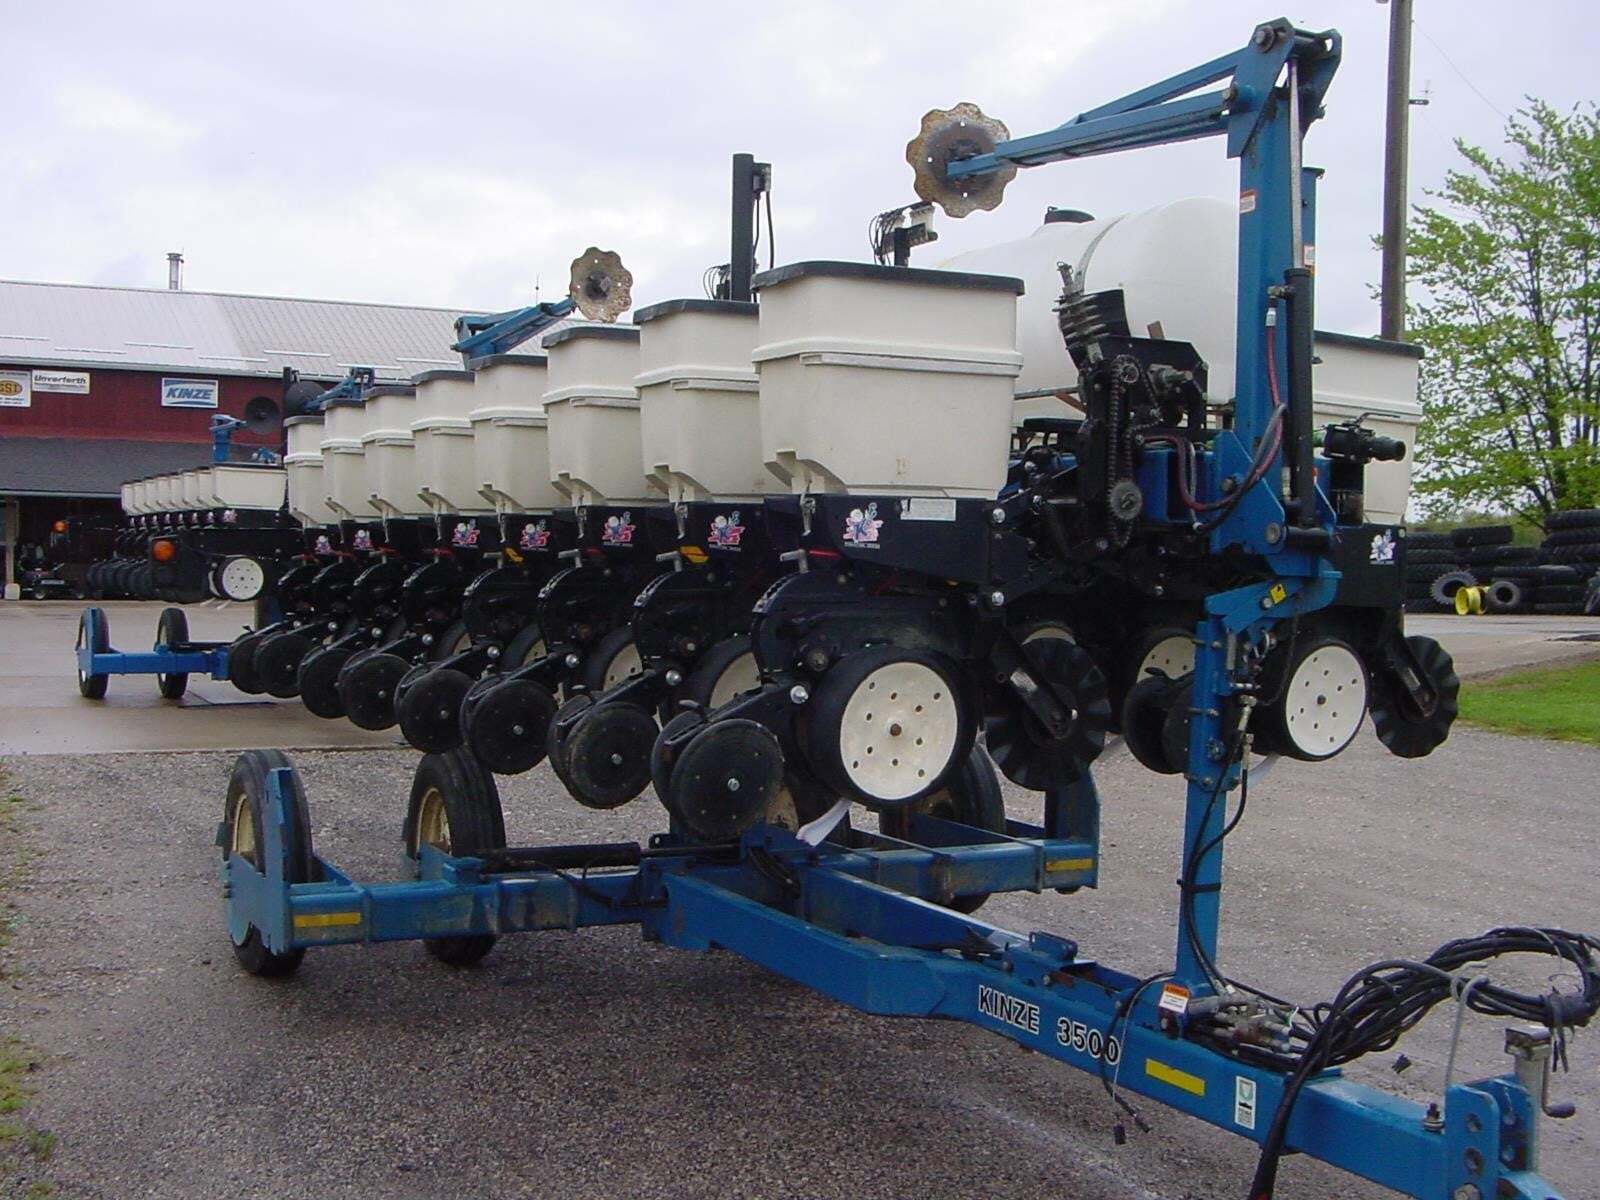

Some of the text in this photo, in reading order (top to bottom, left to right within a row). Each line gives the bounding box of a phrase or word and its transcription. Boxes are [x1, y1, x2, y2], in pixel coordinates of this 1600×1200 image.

[166, 387, 214, 400] KINZE
[978, 984, 1121, 1066] KINZE 3500
